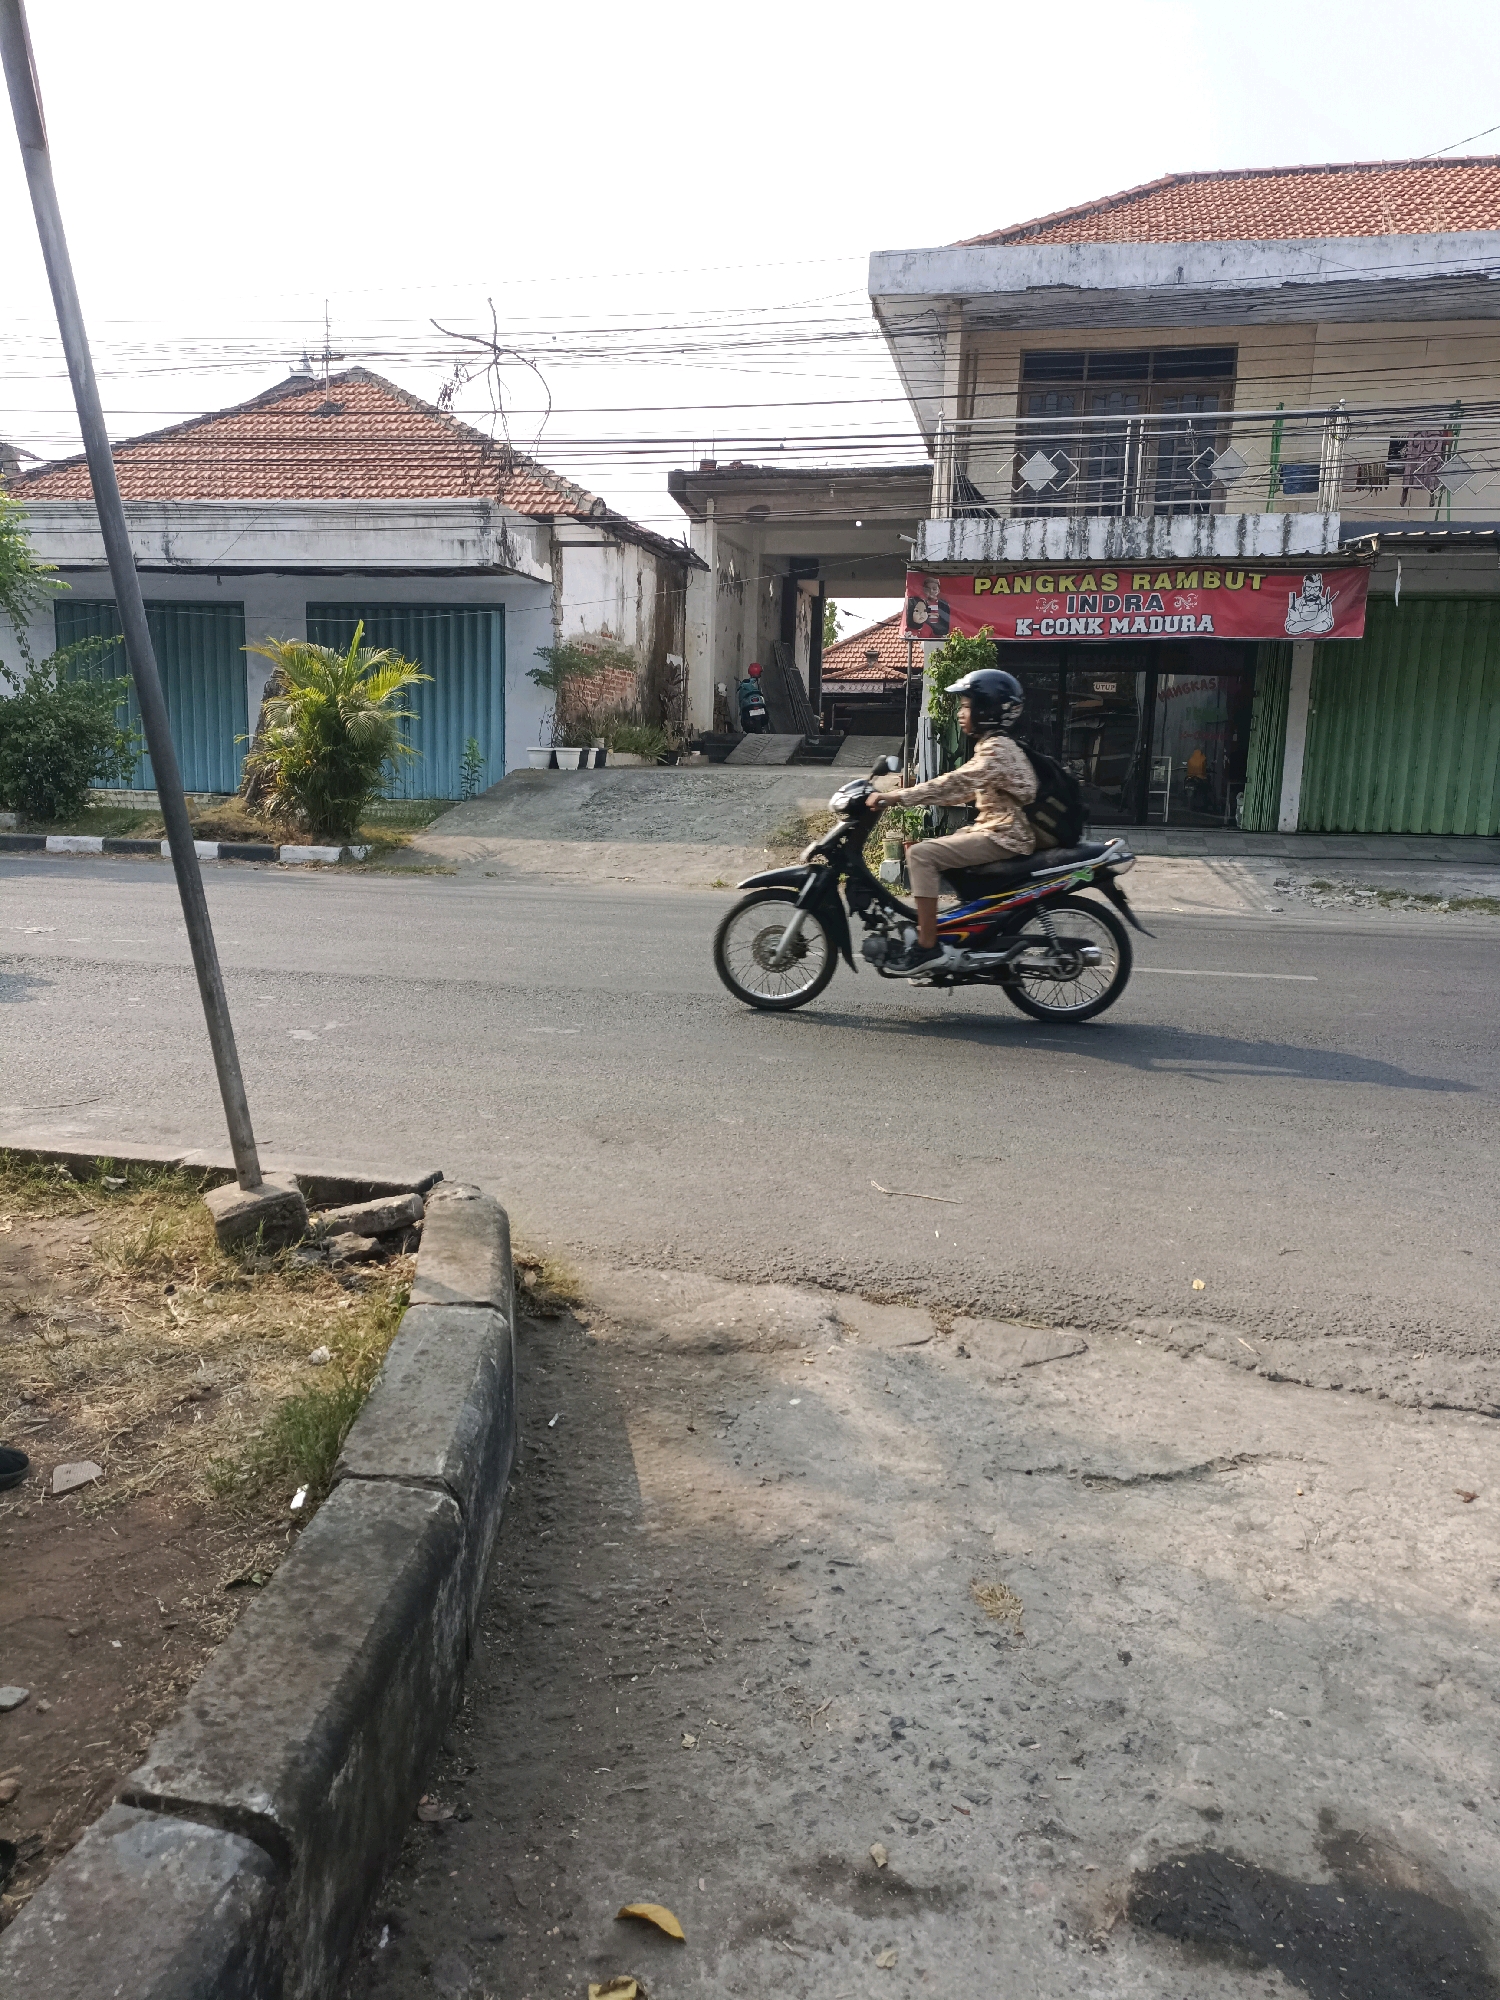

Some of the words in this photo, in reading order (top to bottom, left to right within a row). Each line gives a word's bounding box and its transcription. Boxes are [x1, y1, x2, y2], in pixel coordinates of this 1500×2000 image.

[974, 573, 1119, 594] PANGKAS
[1132, 571, 1266, 591] RAMBUT
[1066, 593, 1165, 614] INDRA
[1015, 617, 1105, 636] K-CONK
[1110, 614, 1215, 635] MADURA
